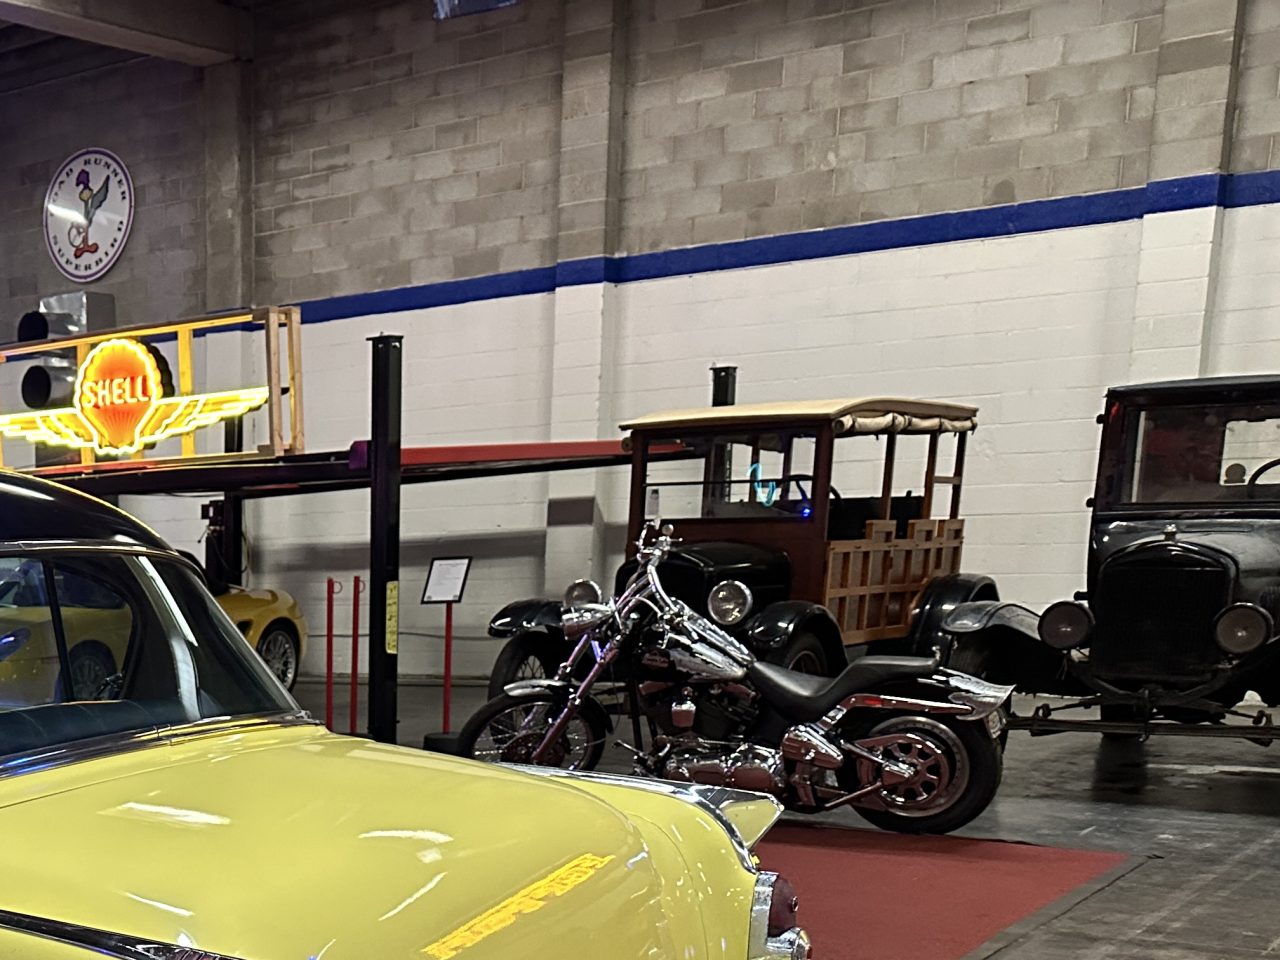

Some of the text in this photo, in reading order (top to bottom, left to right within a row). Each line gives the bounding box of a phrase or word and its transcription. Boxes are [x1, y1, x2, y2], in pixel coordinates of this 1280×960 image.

[83, 157, 127, 201] RUNNER
[52, 220, 124, 272] SUPERBIRD
[82, 375, 150, 409] SHELL
